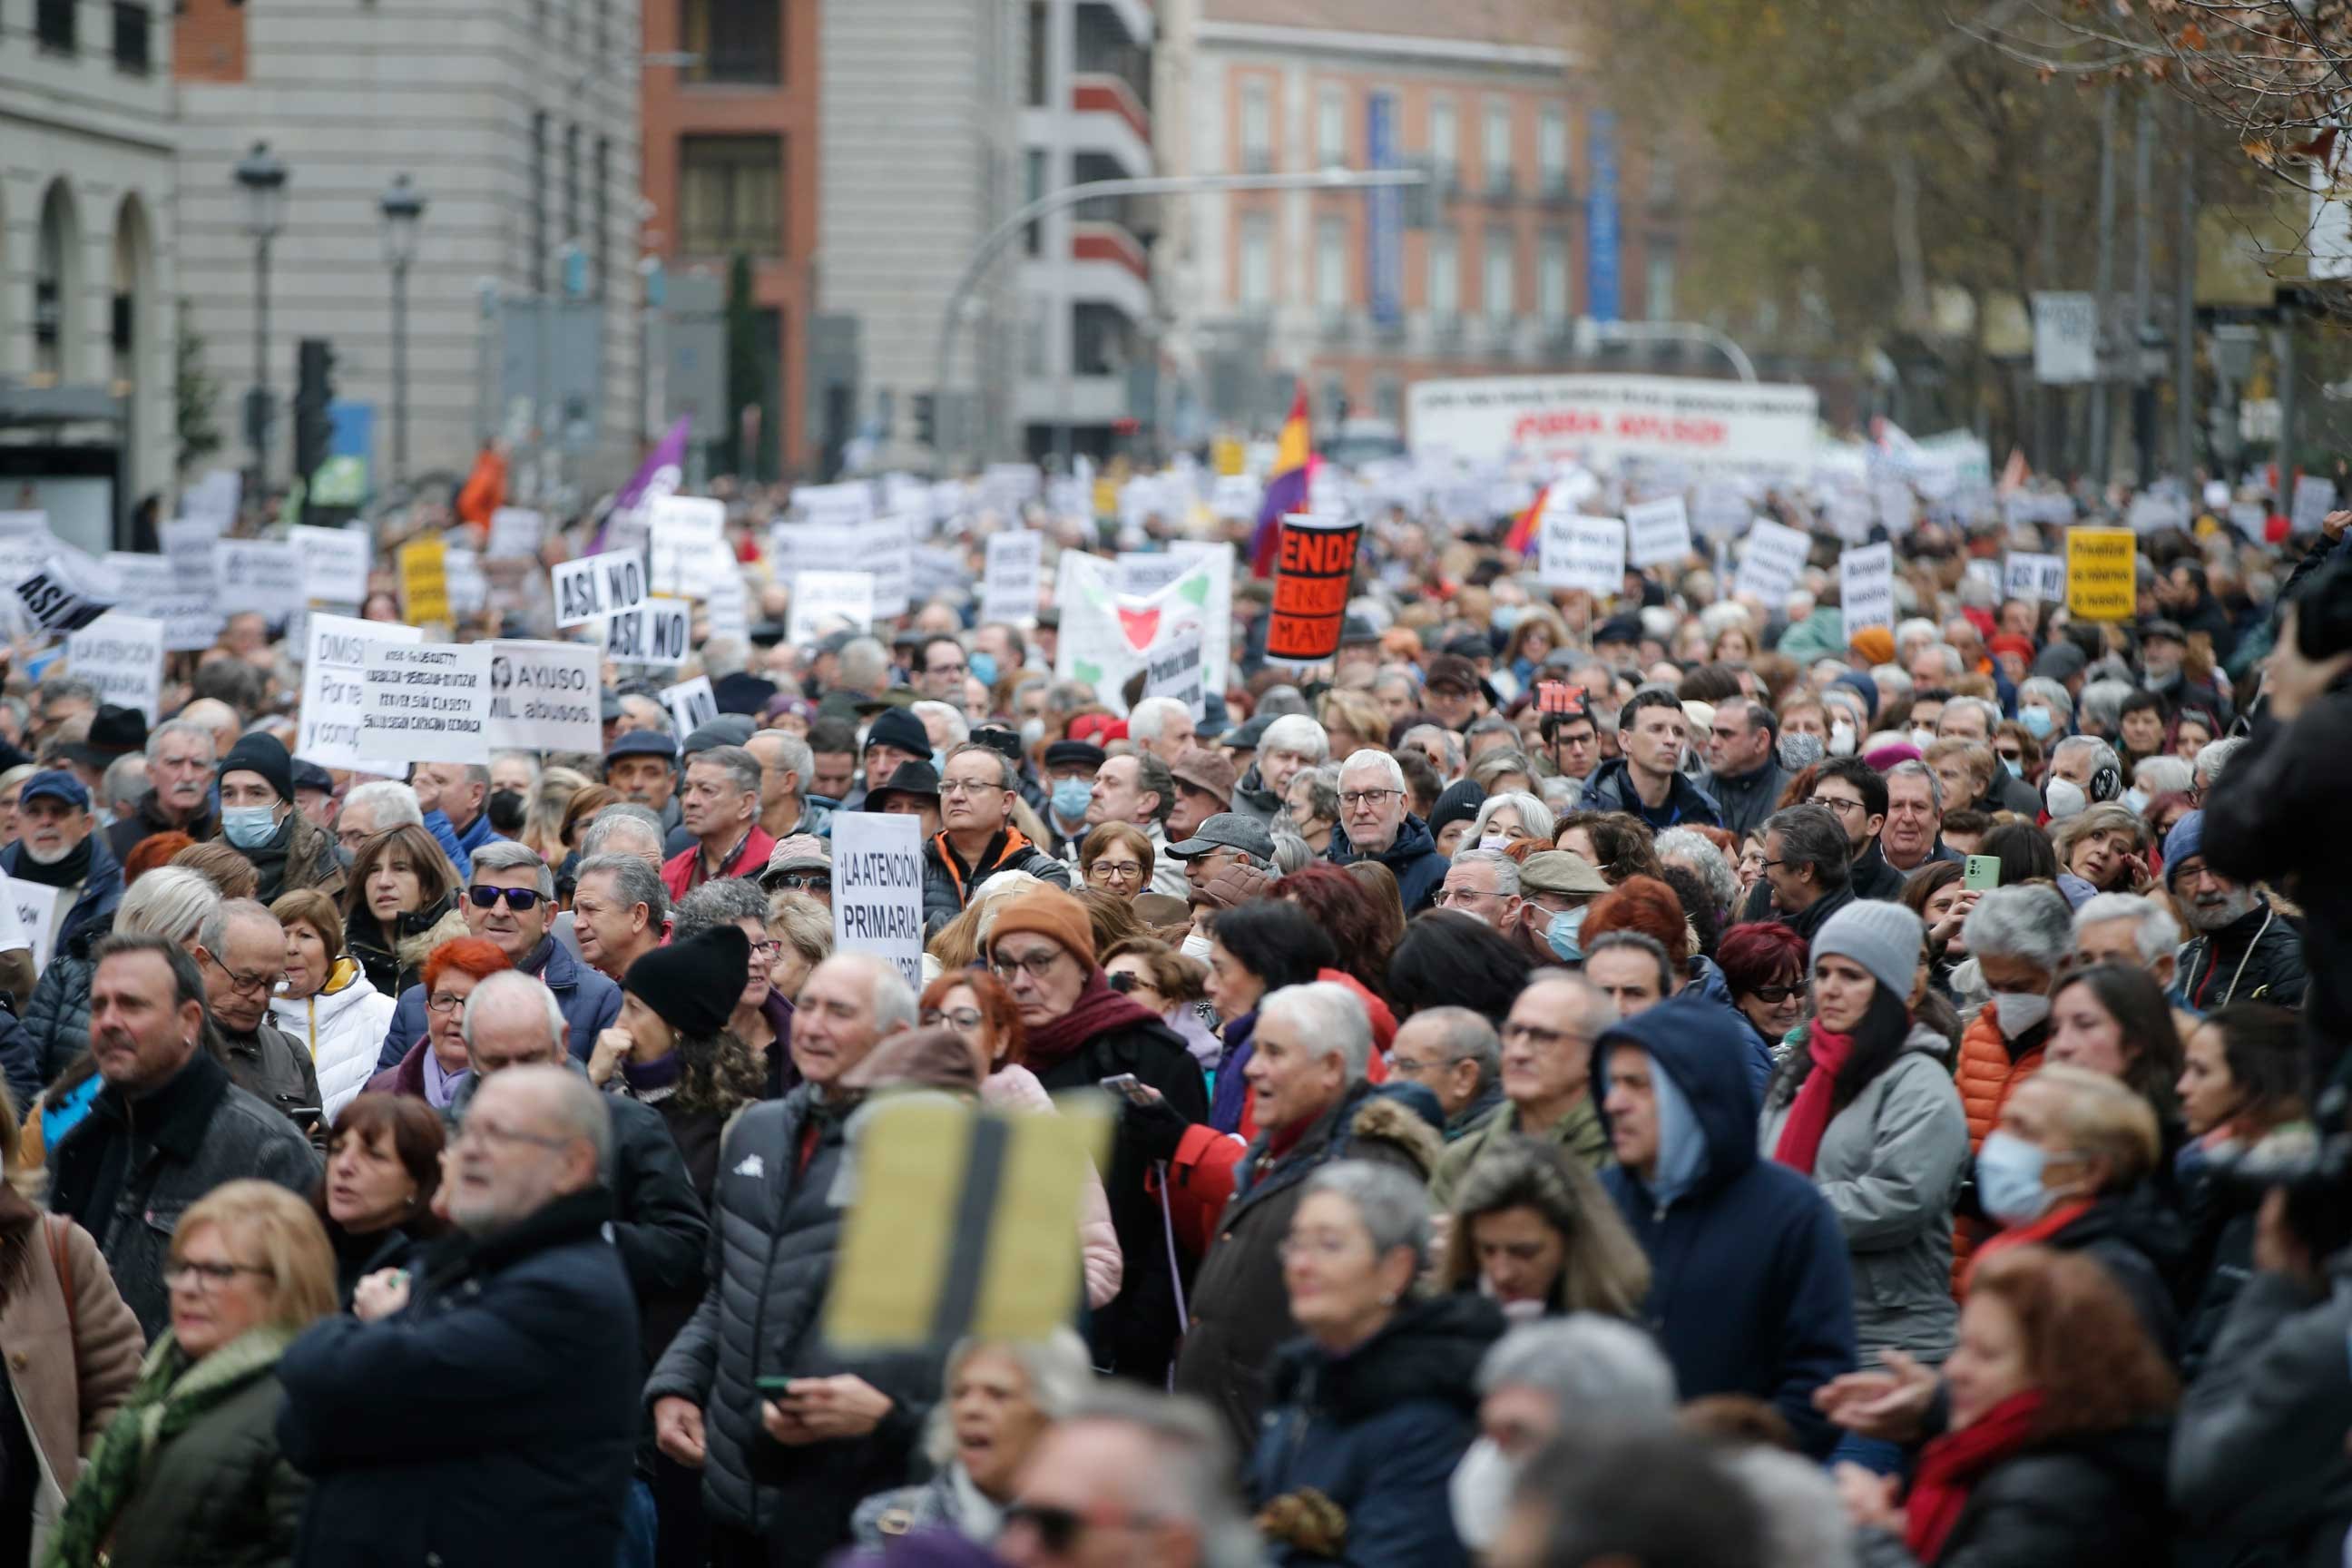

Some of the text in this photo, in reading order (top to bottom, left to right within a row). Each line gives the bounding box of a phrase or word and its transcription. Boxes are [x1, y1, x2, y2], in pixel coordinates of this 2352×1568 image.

[608, 563, 639, 608] NO
[652, 612, 683, 658] NO
[841, 845, 919, 895] ¡LA ATENCIÓN
